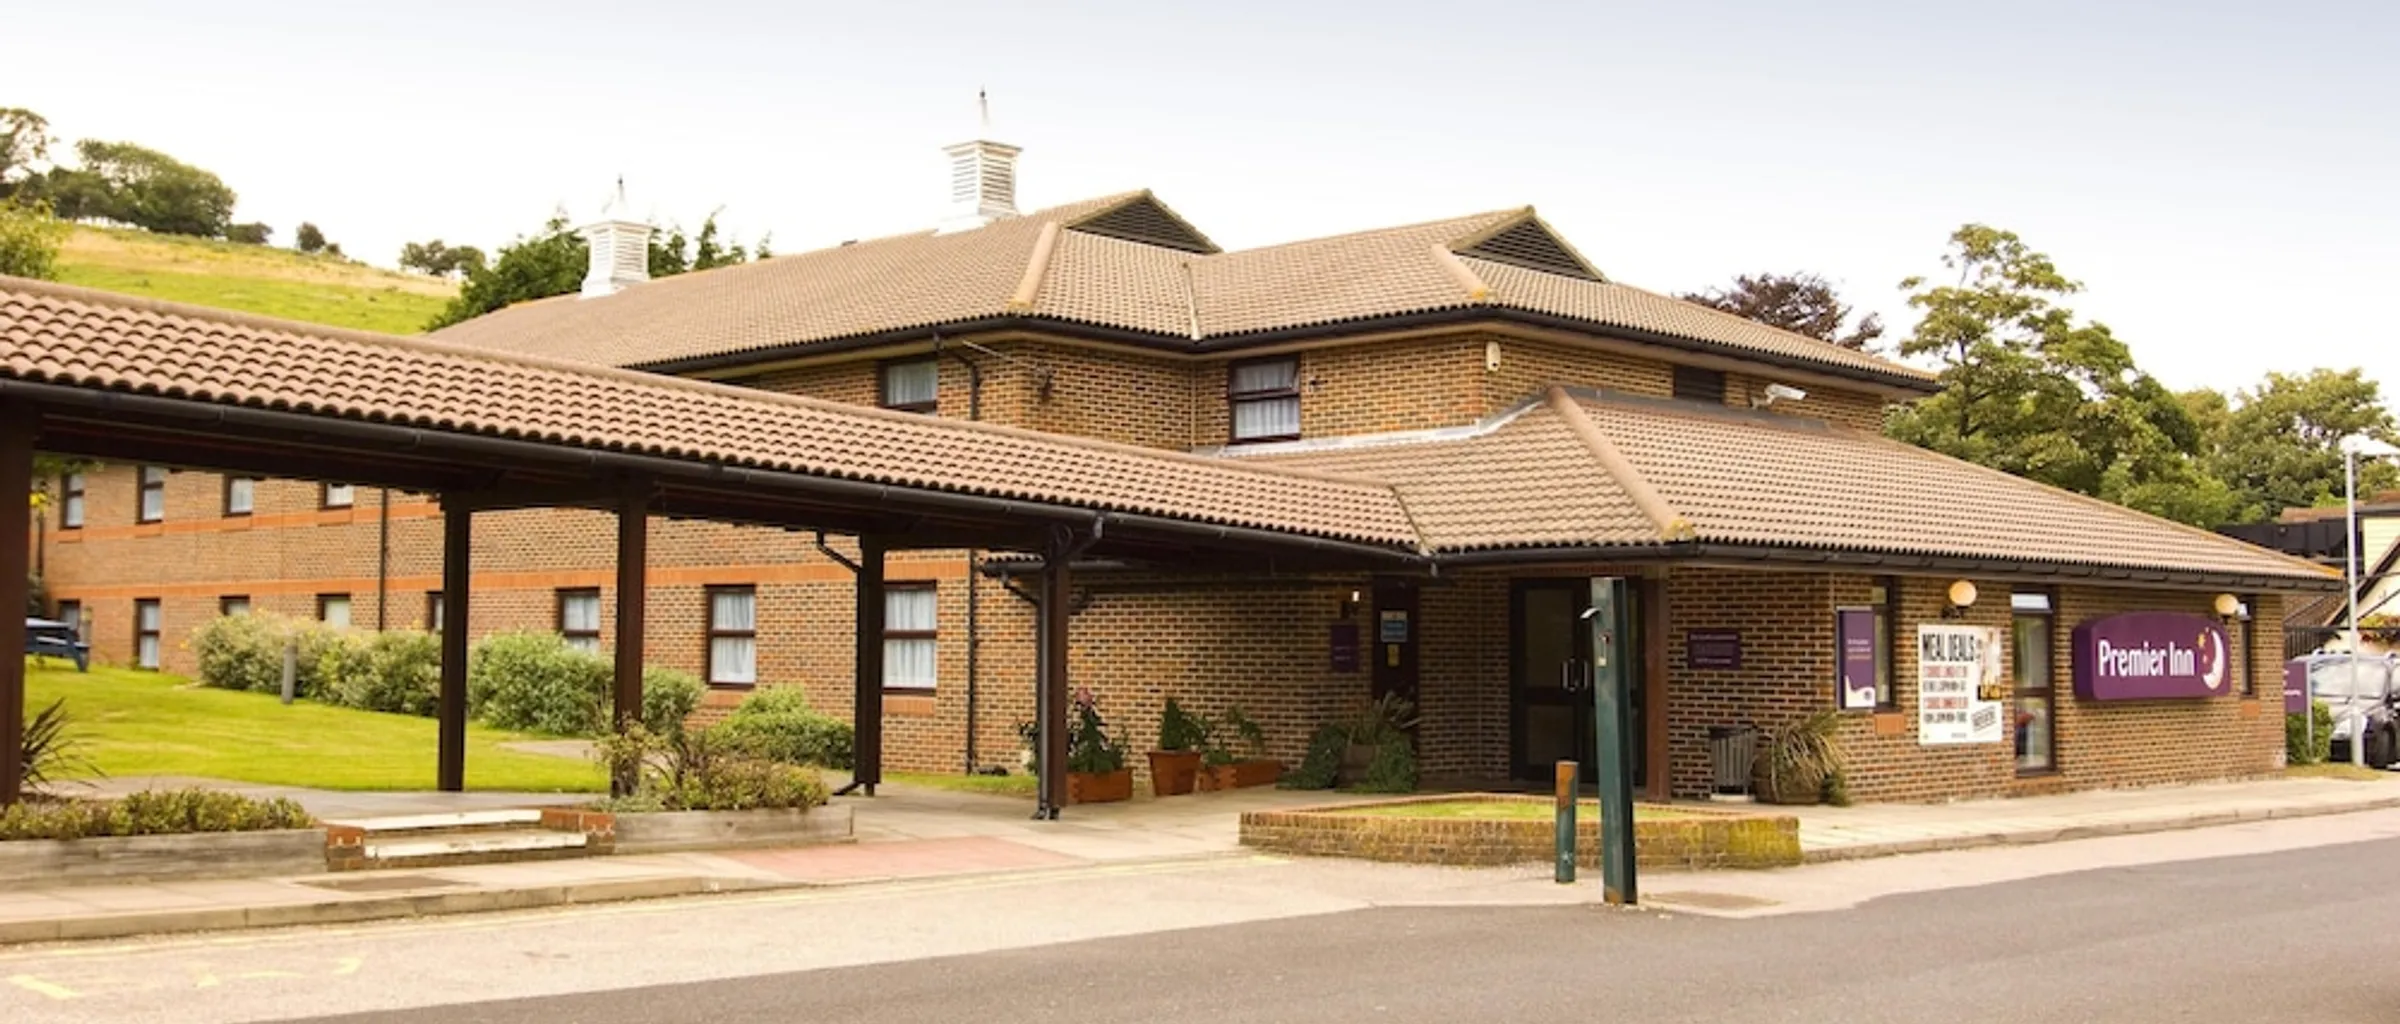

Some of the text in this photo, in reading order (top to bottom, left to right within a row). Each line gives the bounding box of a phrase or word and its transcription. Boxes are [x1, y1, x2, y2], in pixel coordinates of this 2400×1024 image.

[1922, 633, 1946, 661] MEAL
[1949, 633, 1974, 661] DEALS
[2098, 639, 2195, 677] Premier Inn
